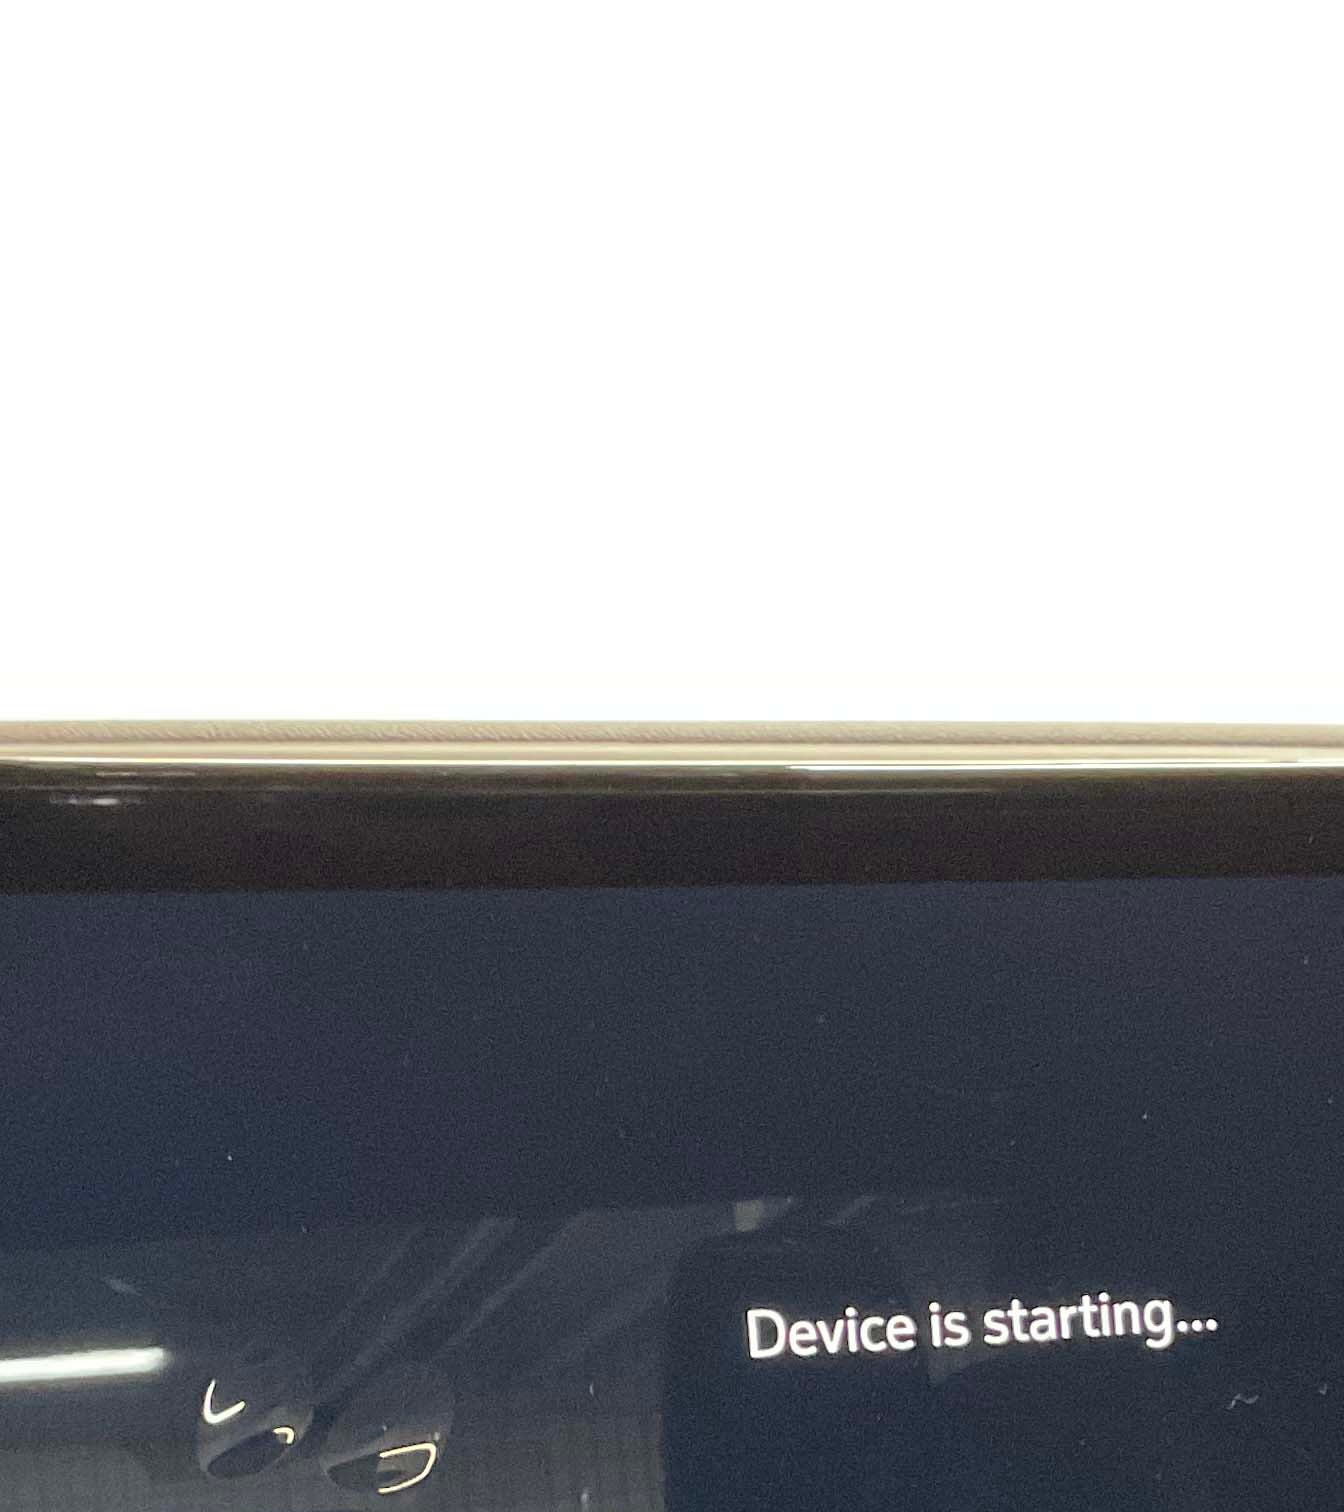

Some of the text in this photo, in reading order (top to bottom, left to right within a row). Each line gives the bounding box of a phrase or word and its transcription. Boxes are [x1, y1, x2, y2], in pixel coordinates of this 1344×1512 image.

[745, 1291, 1219, 1359] Device is starting...
